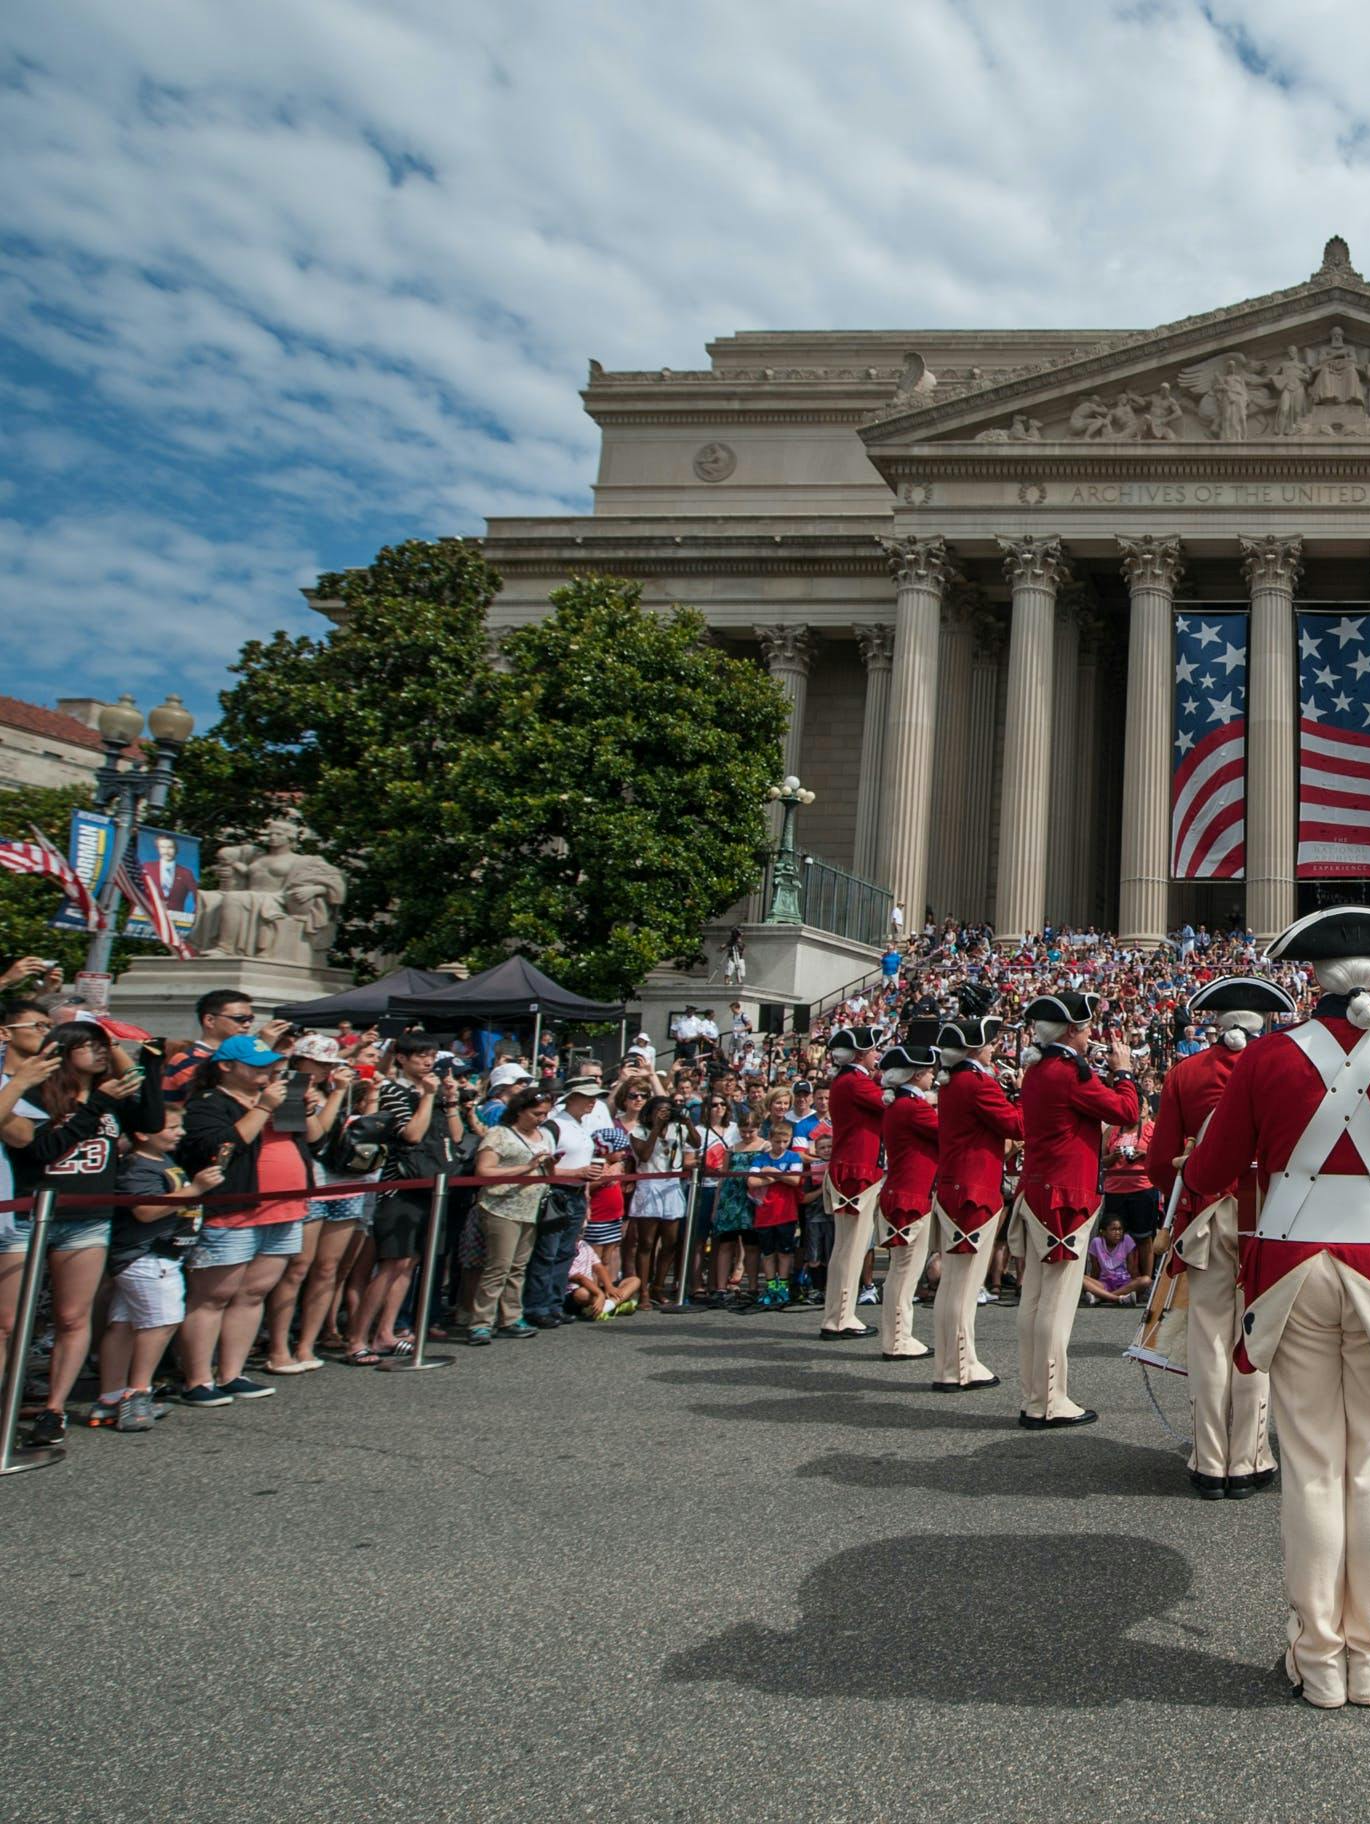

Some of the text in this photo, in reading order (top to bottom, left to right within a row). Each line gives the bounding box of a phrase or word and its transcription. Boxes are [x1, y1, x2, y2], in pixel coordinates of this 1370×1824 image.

[1071, 485, 1186, 504] ARCHIVES
[1194, 485, 1223, 503] OF
[1231, 486, 1273, 503] THE
[1281, 486, 1366, 503] UNITED
